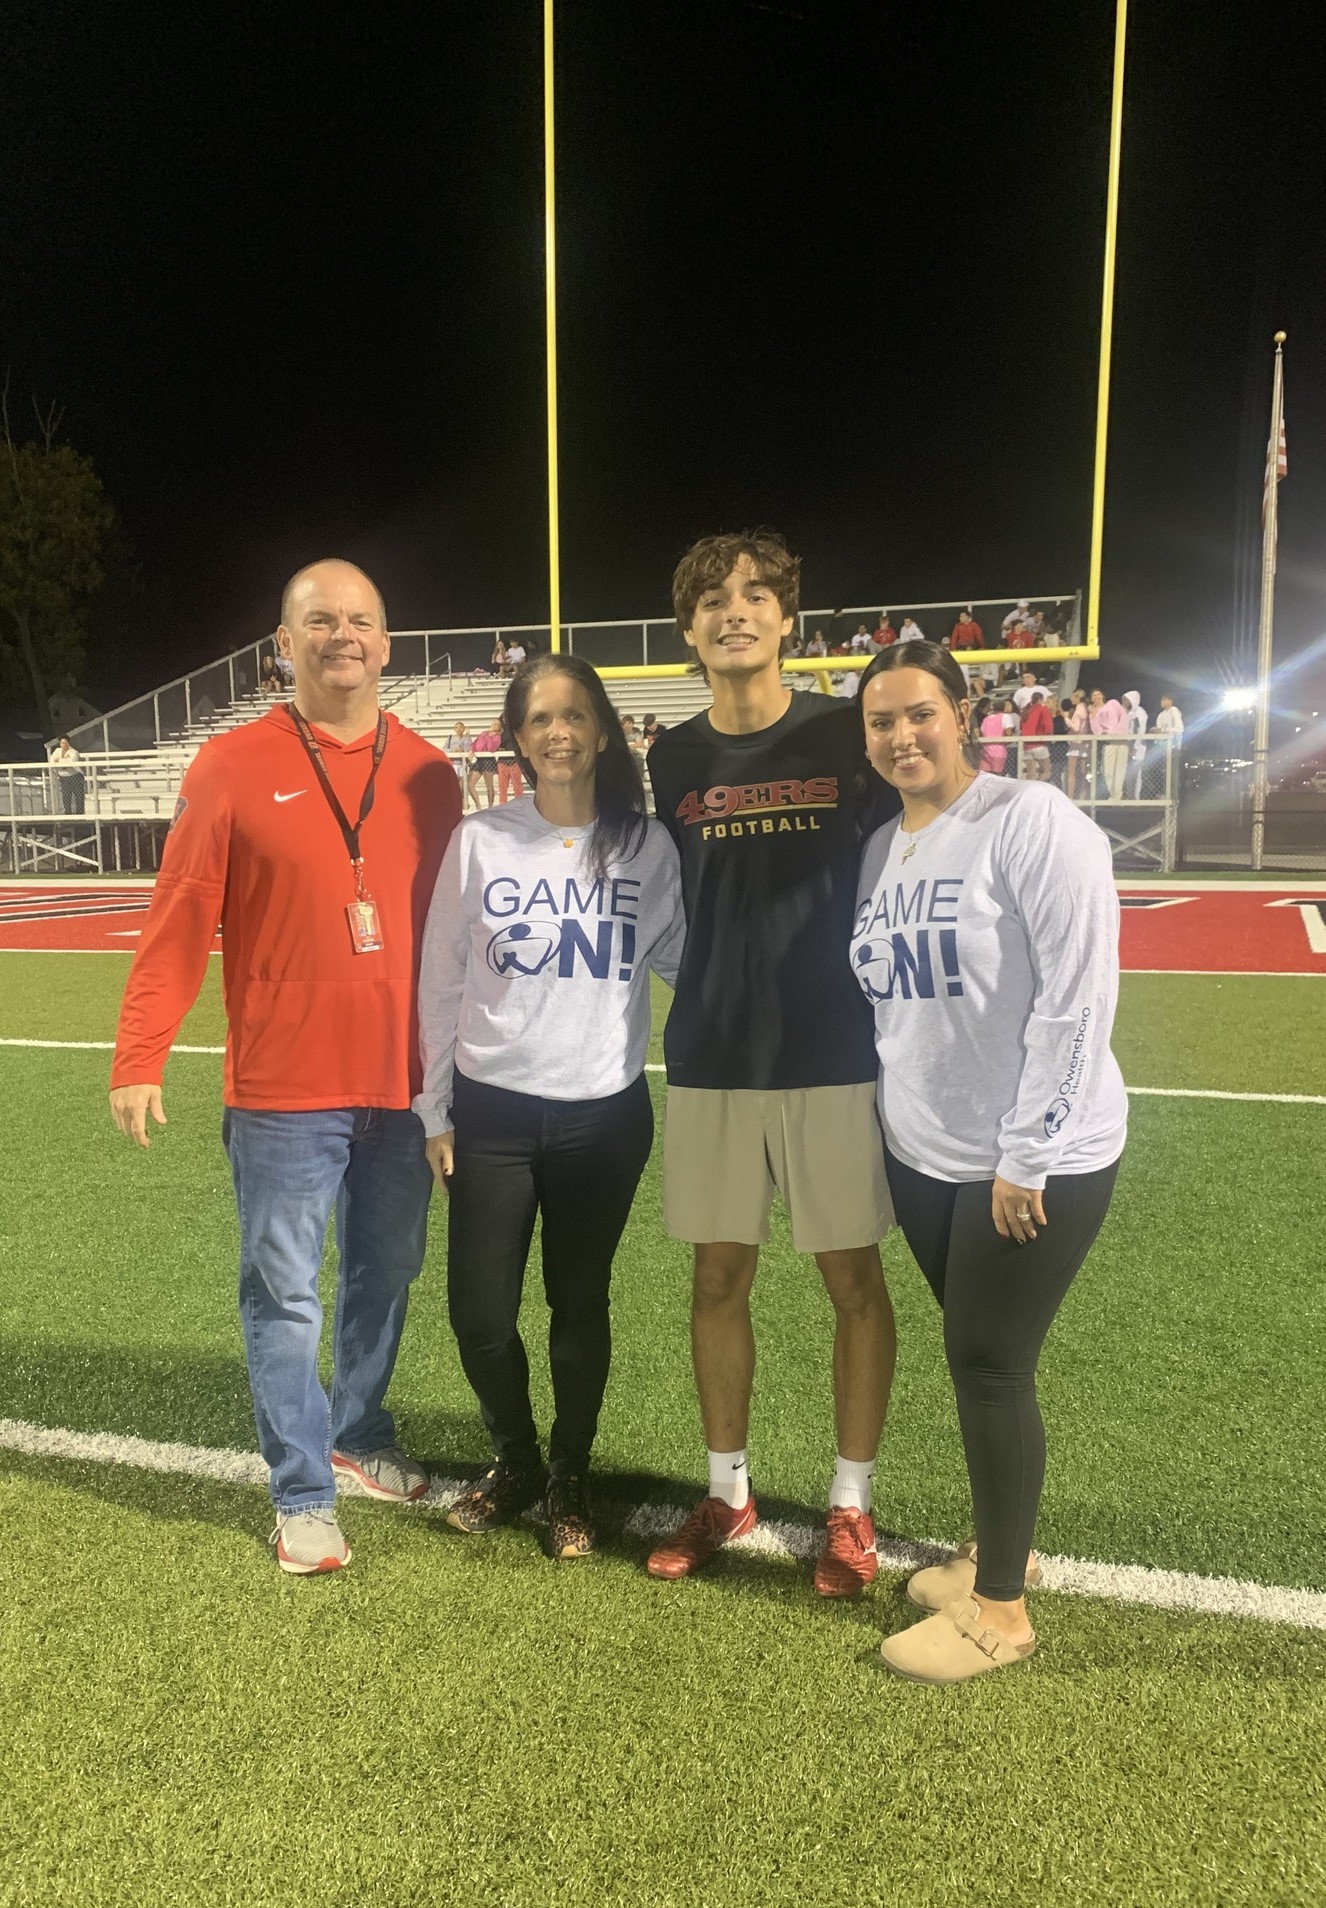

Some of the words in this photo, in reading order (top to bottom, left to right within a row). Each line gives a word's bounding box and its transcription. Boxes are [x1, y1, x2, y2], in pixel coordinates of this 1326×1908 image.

[675, 777, 839, 825] 49ERS
[702, 816, 821, 841] FOOTBALL
[484, 877, 640, 920] GAME
[851, 879, 964, 940] GAME
[1059, 1007, 1091, 1095] Owensboro
[1070, 1055, 1087, 1095] Health
